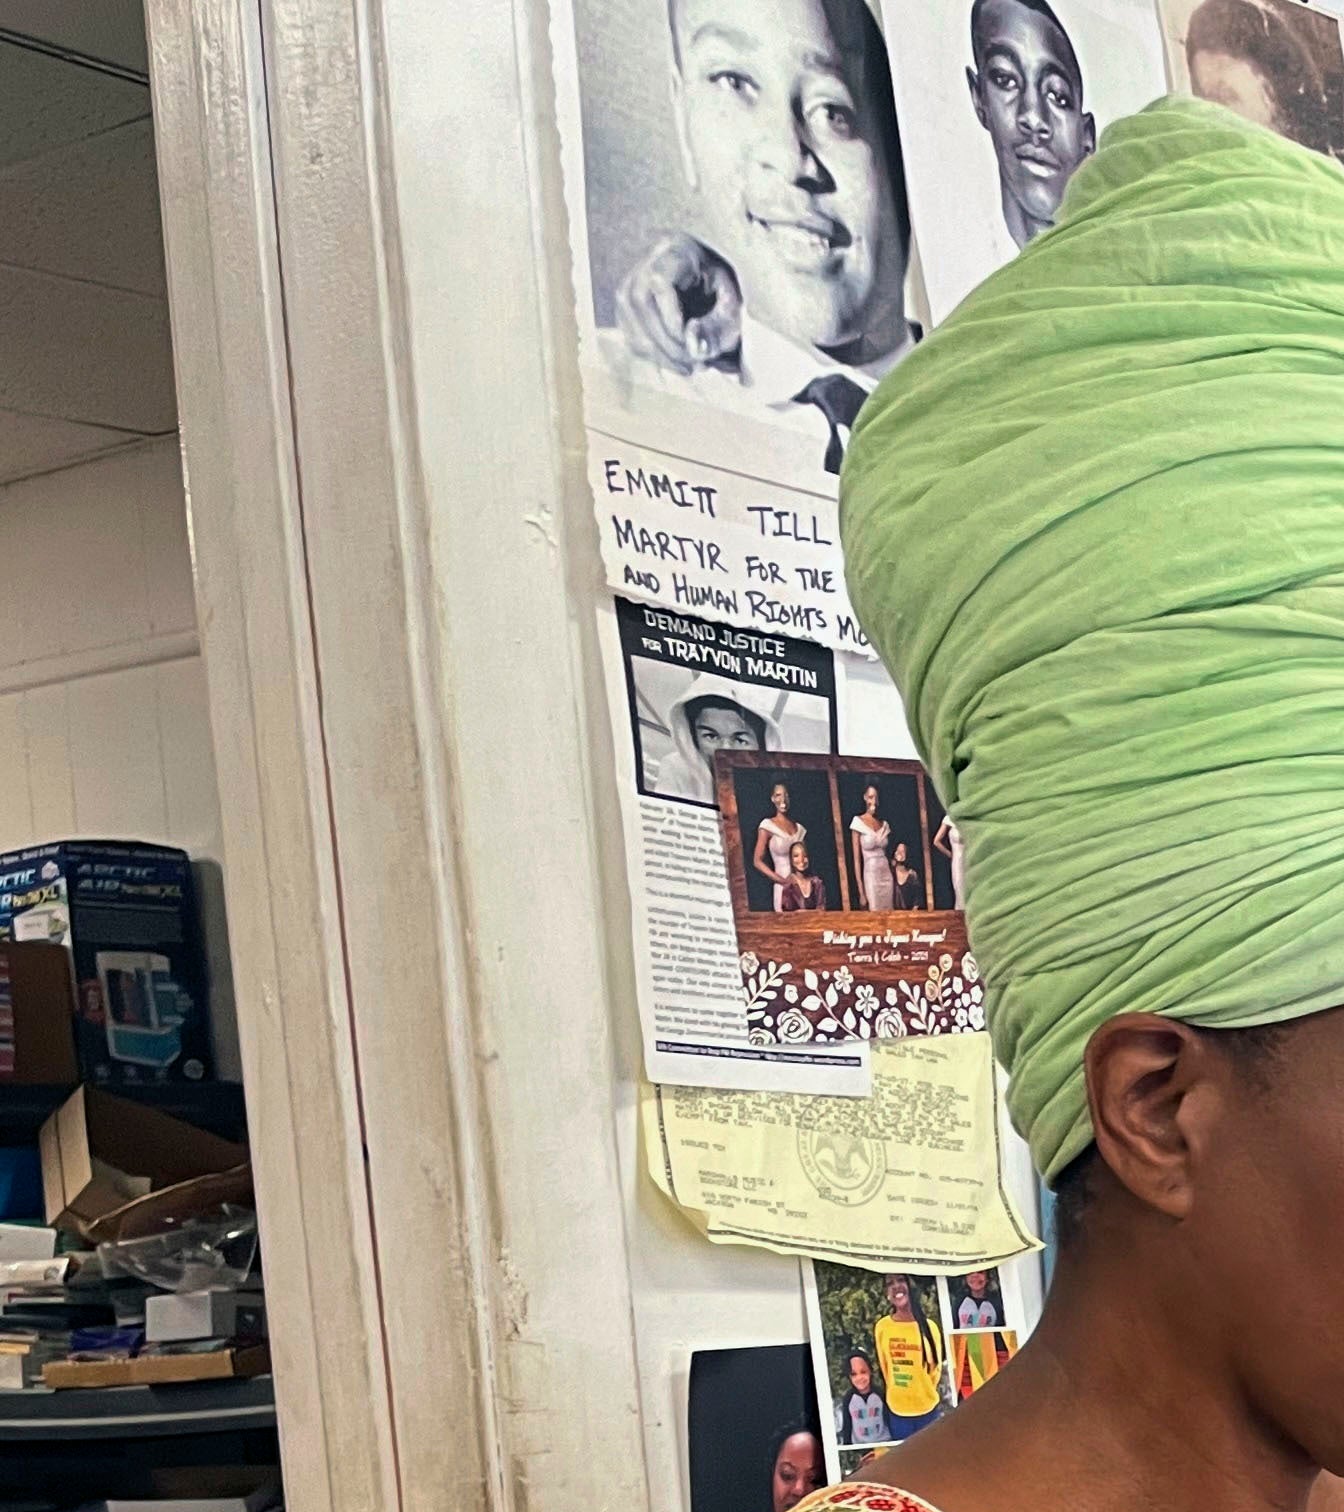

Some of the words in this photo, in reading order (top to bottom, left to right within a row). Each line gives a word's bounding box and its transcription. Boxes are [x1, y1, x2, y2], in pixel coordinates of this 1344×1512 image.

[747, 506, 834, 547] TILL
[611, 516, 731, 574] MARTYR
[745, 555, 787, 594] FOR
[794, 566, 837, 593] THE
[624, 565, 661, 595] AND
[674, 571, 740, 616] HUMAN
[644, 609, 716, 644] DEMAND
[719, 628, 785, 658] JUSTICE
[663, 639, 742, 675] TRAYVON
[747, 656, 818, 688] MARTIN
